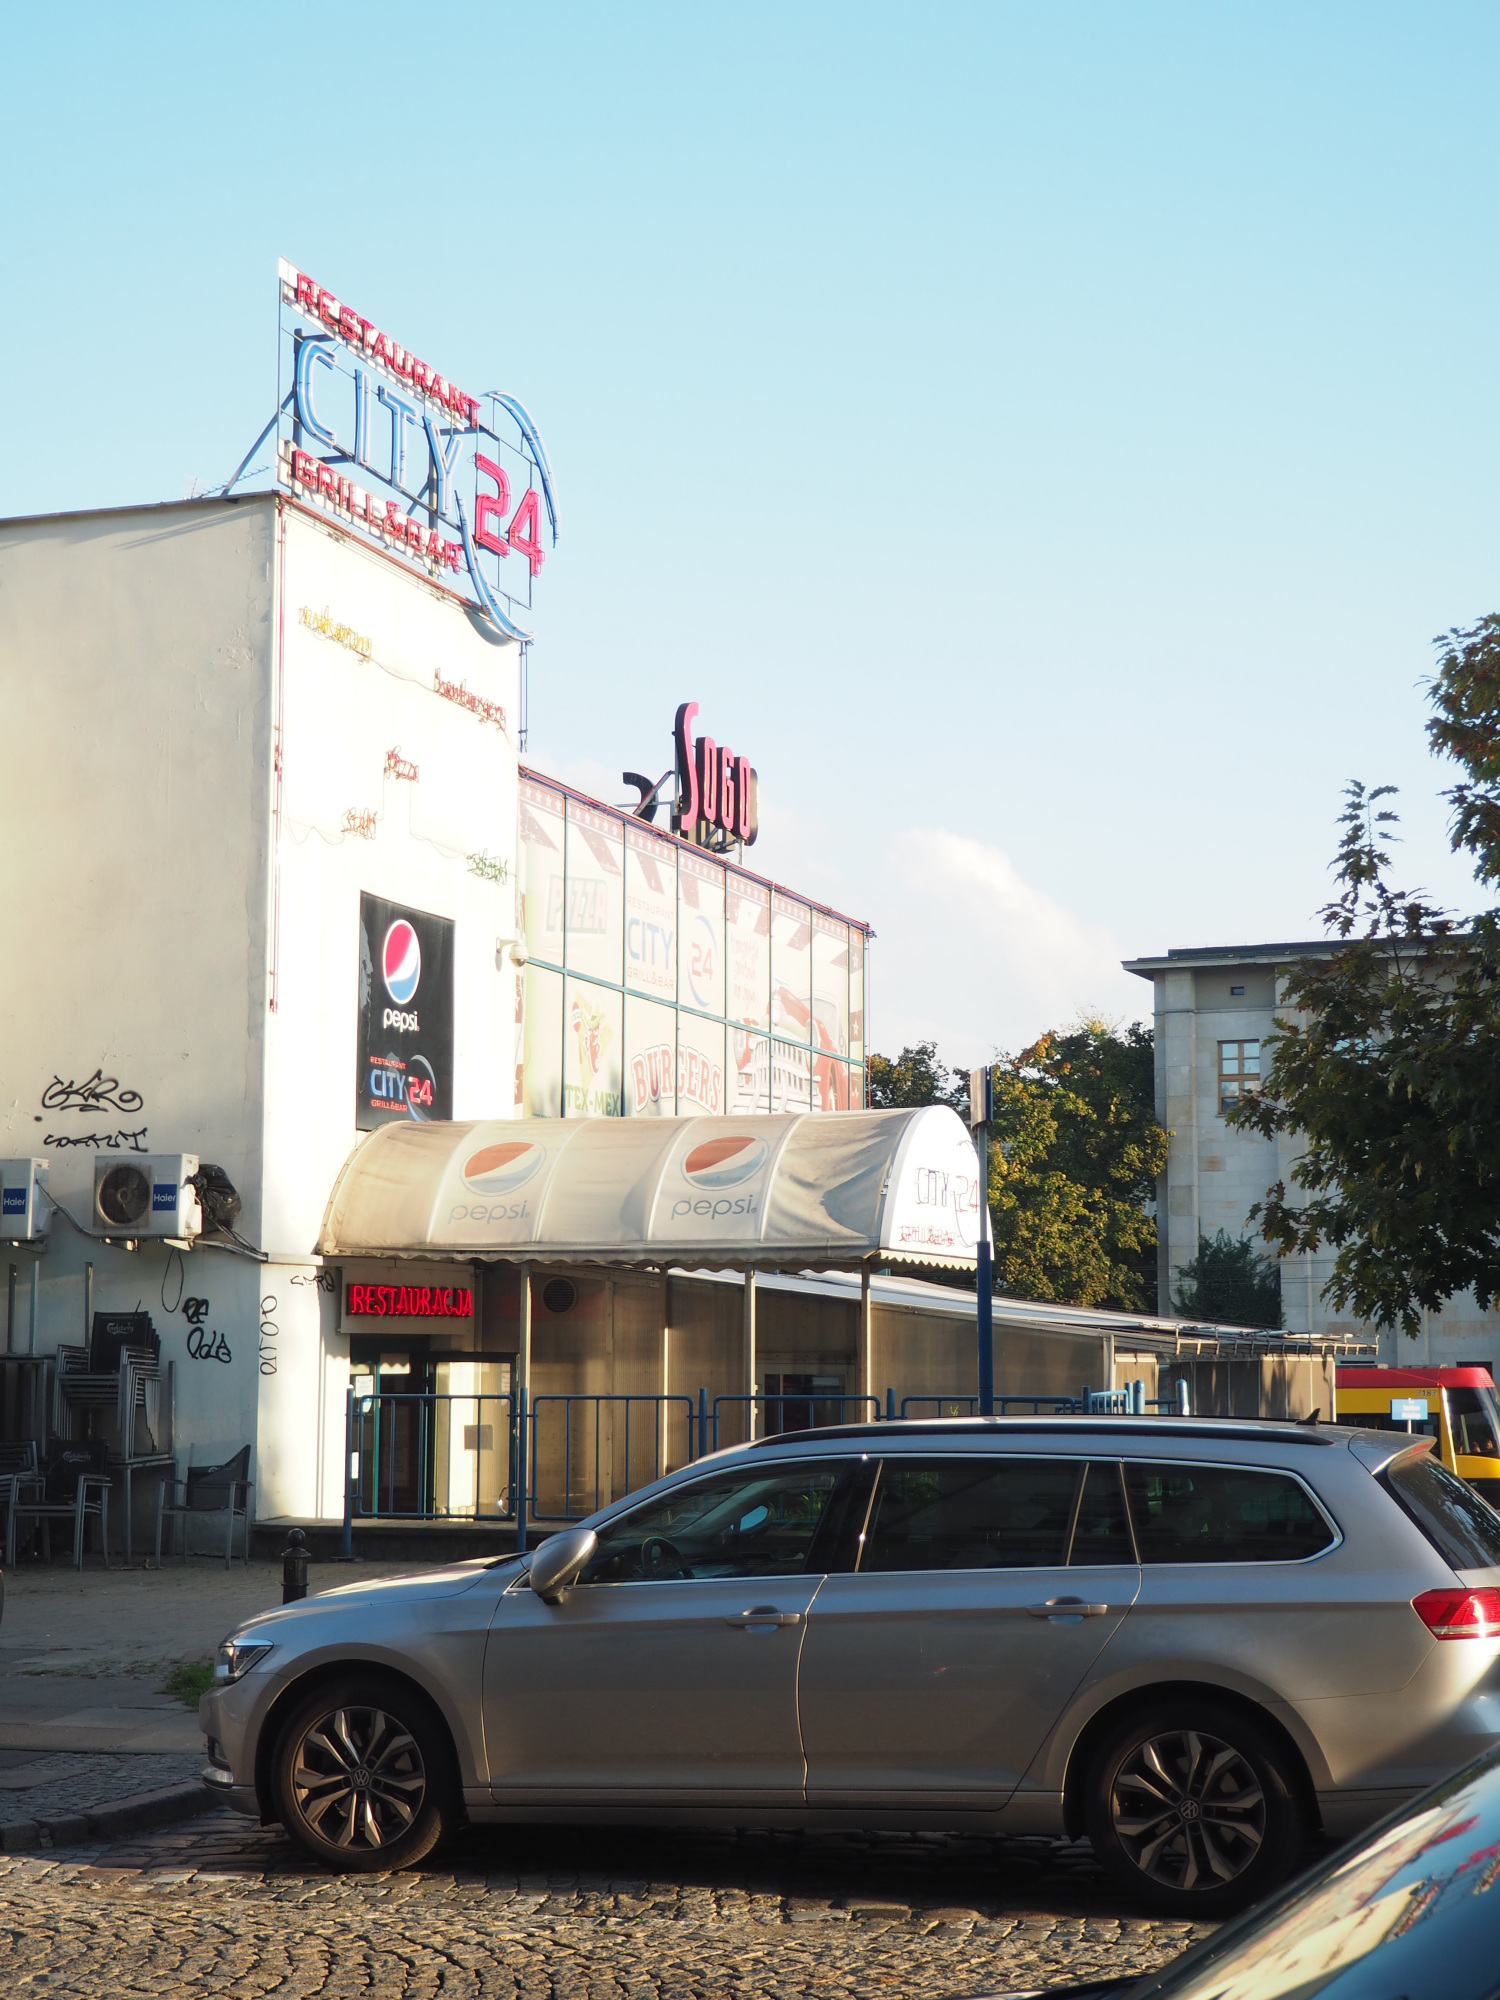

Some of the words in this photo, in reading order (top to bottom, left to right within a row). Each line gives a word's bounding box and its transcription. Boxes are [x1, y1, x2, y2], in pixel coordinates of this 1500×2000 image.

[297, 272, 482, 428] RESTAURANT
[297, 339, 464, 516] CITY
[475, 452, 546, 577] 24
[292, 448, 464, 575] GRILL&BAR
[675, 701, 750, 840] SOGO
[546, 875, 607, 934] PIZZA
[627, 895, 675, 919] RESTAURANT
[627, 916, 675, 972] CITY
[691, 942, 714, 983] 24
[626, 965, 675, 993] GRILL&BAR
[383, 1007, 419, 1032] pepsi
[370, 1056, 406, 1069] RESTAURANT
[632, 1043, 721, 1115] BURGERS
[370, 1069, 406, 1100] CITY
[408, 1076, 433, 1106] 24
[565, 1083, 621, 1118] TEX-MEX
[371, 1100, 407, 1112] GRILL&BAR
[3, 1197, 25, 1207] Haier
[153, 1193, 176, 1202] Haier
[915, 1167, 949, 1208] CITY
[448, 1199, 528, 1225] pepsi
[670, 1195, 753, 1221] pepsi
[351, 1284, 474, 1317] RESTAURACJA
